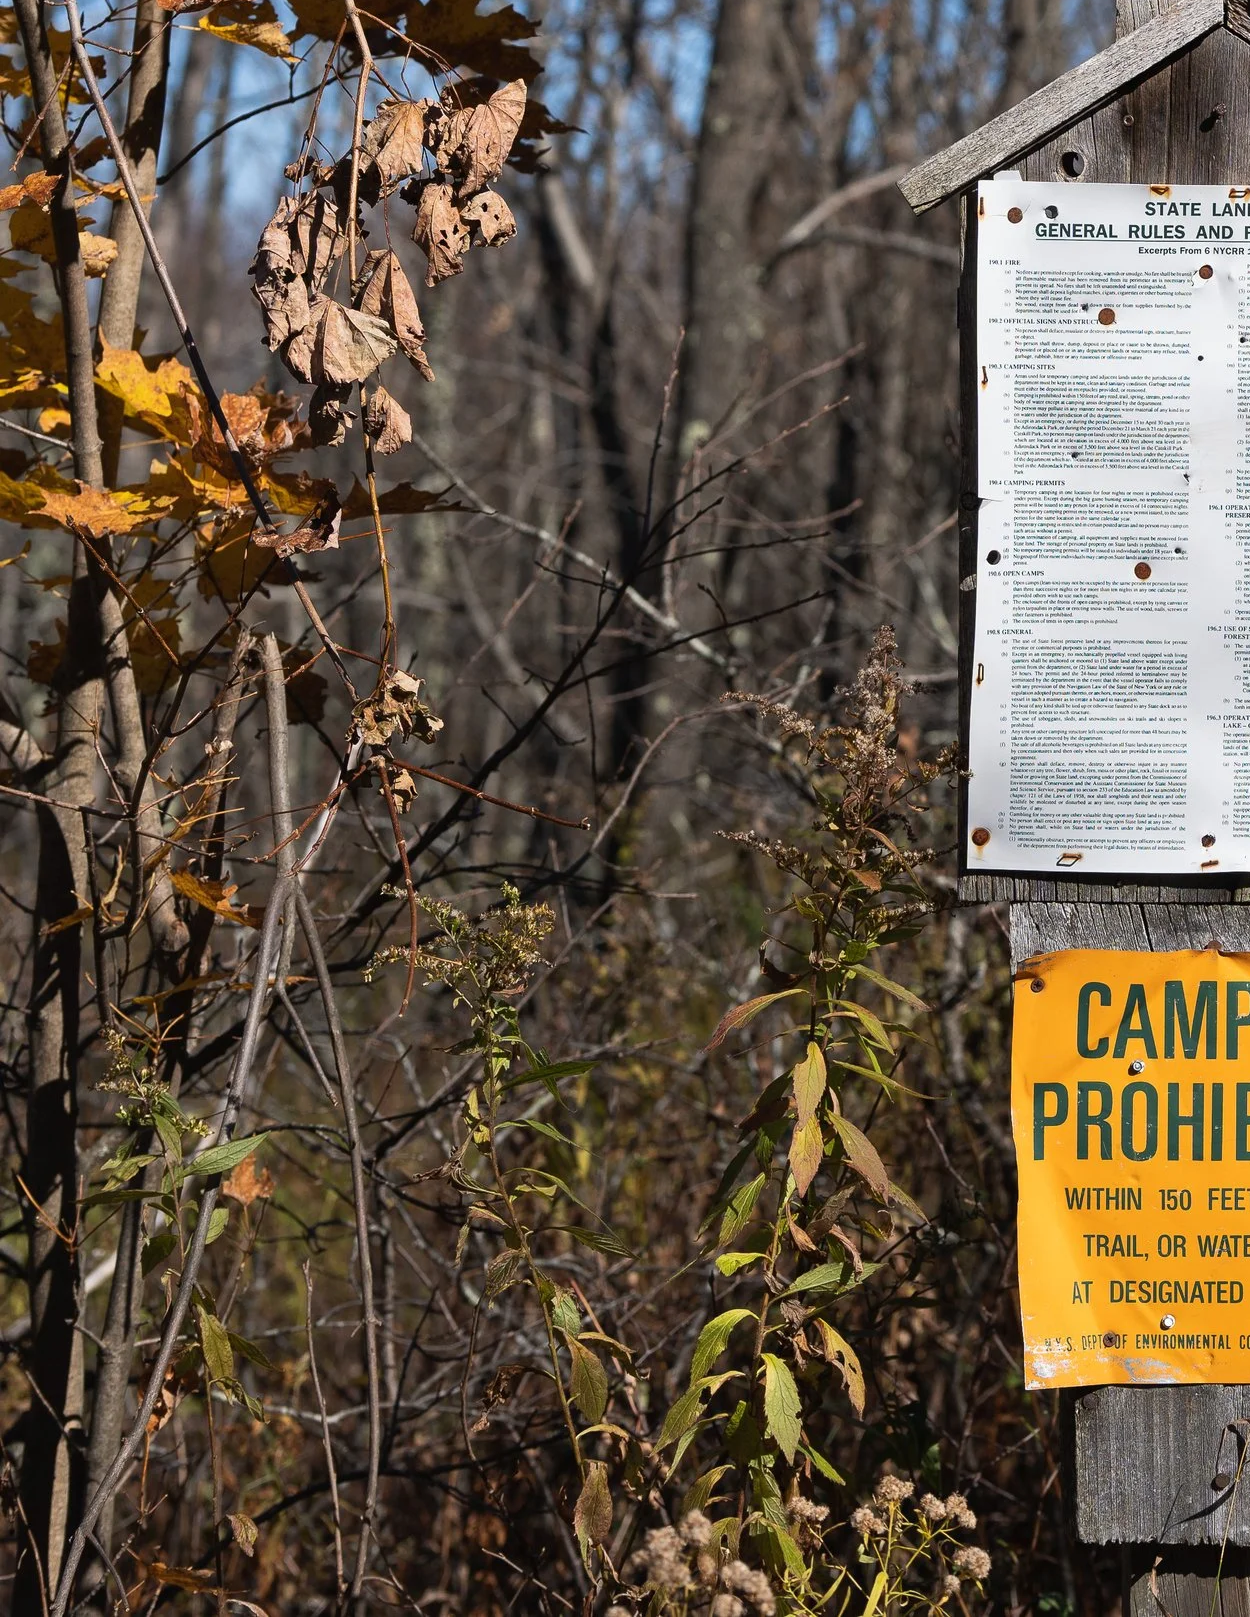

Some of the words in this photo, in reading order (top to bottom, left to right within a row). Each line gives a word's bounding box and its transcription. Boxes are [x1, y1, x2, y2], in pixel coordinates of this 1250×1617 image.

[1144, 201, 1201, 216] STATE
[1035, 222, 1118, 238] GENERAL
[1128, 224, 1185, 239] RULES
[1195, 225, 1233, 239] AND
[1138, 246, 1176, 255] Excerpts
[1179, 246, 1201, 254] From
[1204, 246, 1210, 254] 6
[1213, 246, 1244, 255] NYCRR
[1005, 258, 1020, 266] FIRE
[1003, 317, 1035, 325] OFFICIAL
[1036, 317, 1056, 325] SIGNS
[1057, 317, 1072, 325] AND
[1003, 362, 1035, 370] CAMPING
[1036, 363, 1055, 371] SITES
[1035, 479, 1065, 487] PERMITS
[1002, 569, 1020, 577] OPEN
[1021, 569, 1044, 577] CAMPS
[1223, 624, 1236, 632] USE
[1237, 624, 1247, 632] OF
[1223, 632, 1250, 640] FOREST
[1223, 721, 1241, 729] LAKE
[1065, 1187, 1142, 1211] WITHIN
[1158, 1188, 1192, 1211] 150
[1082, 1233, 1150, 1261] TRAIL,
[1157, 1233, 1187, 1257] OR
[1072, 1280, 1093, 1305] AT
[1109, 1280, 1244, 1304] DESIGNATED
[1114, 1334, 1128, 1349] OF
[1136, 1334, 1231, 1350] ENVIRONMENTAL
